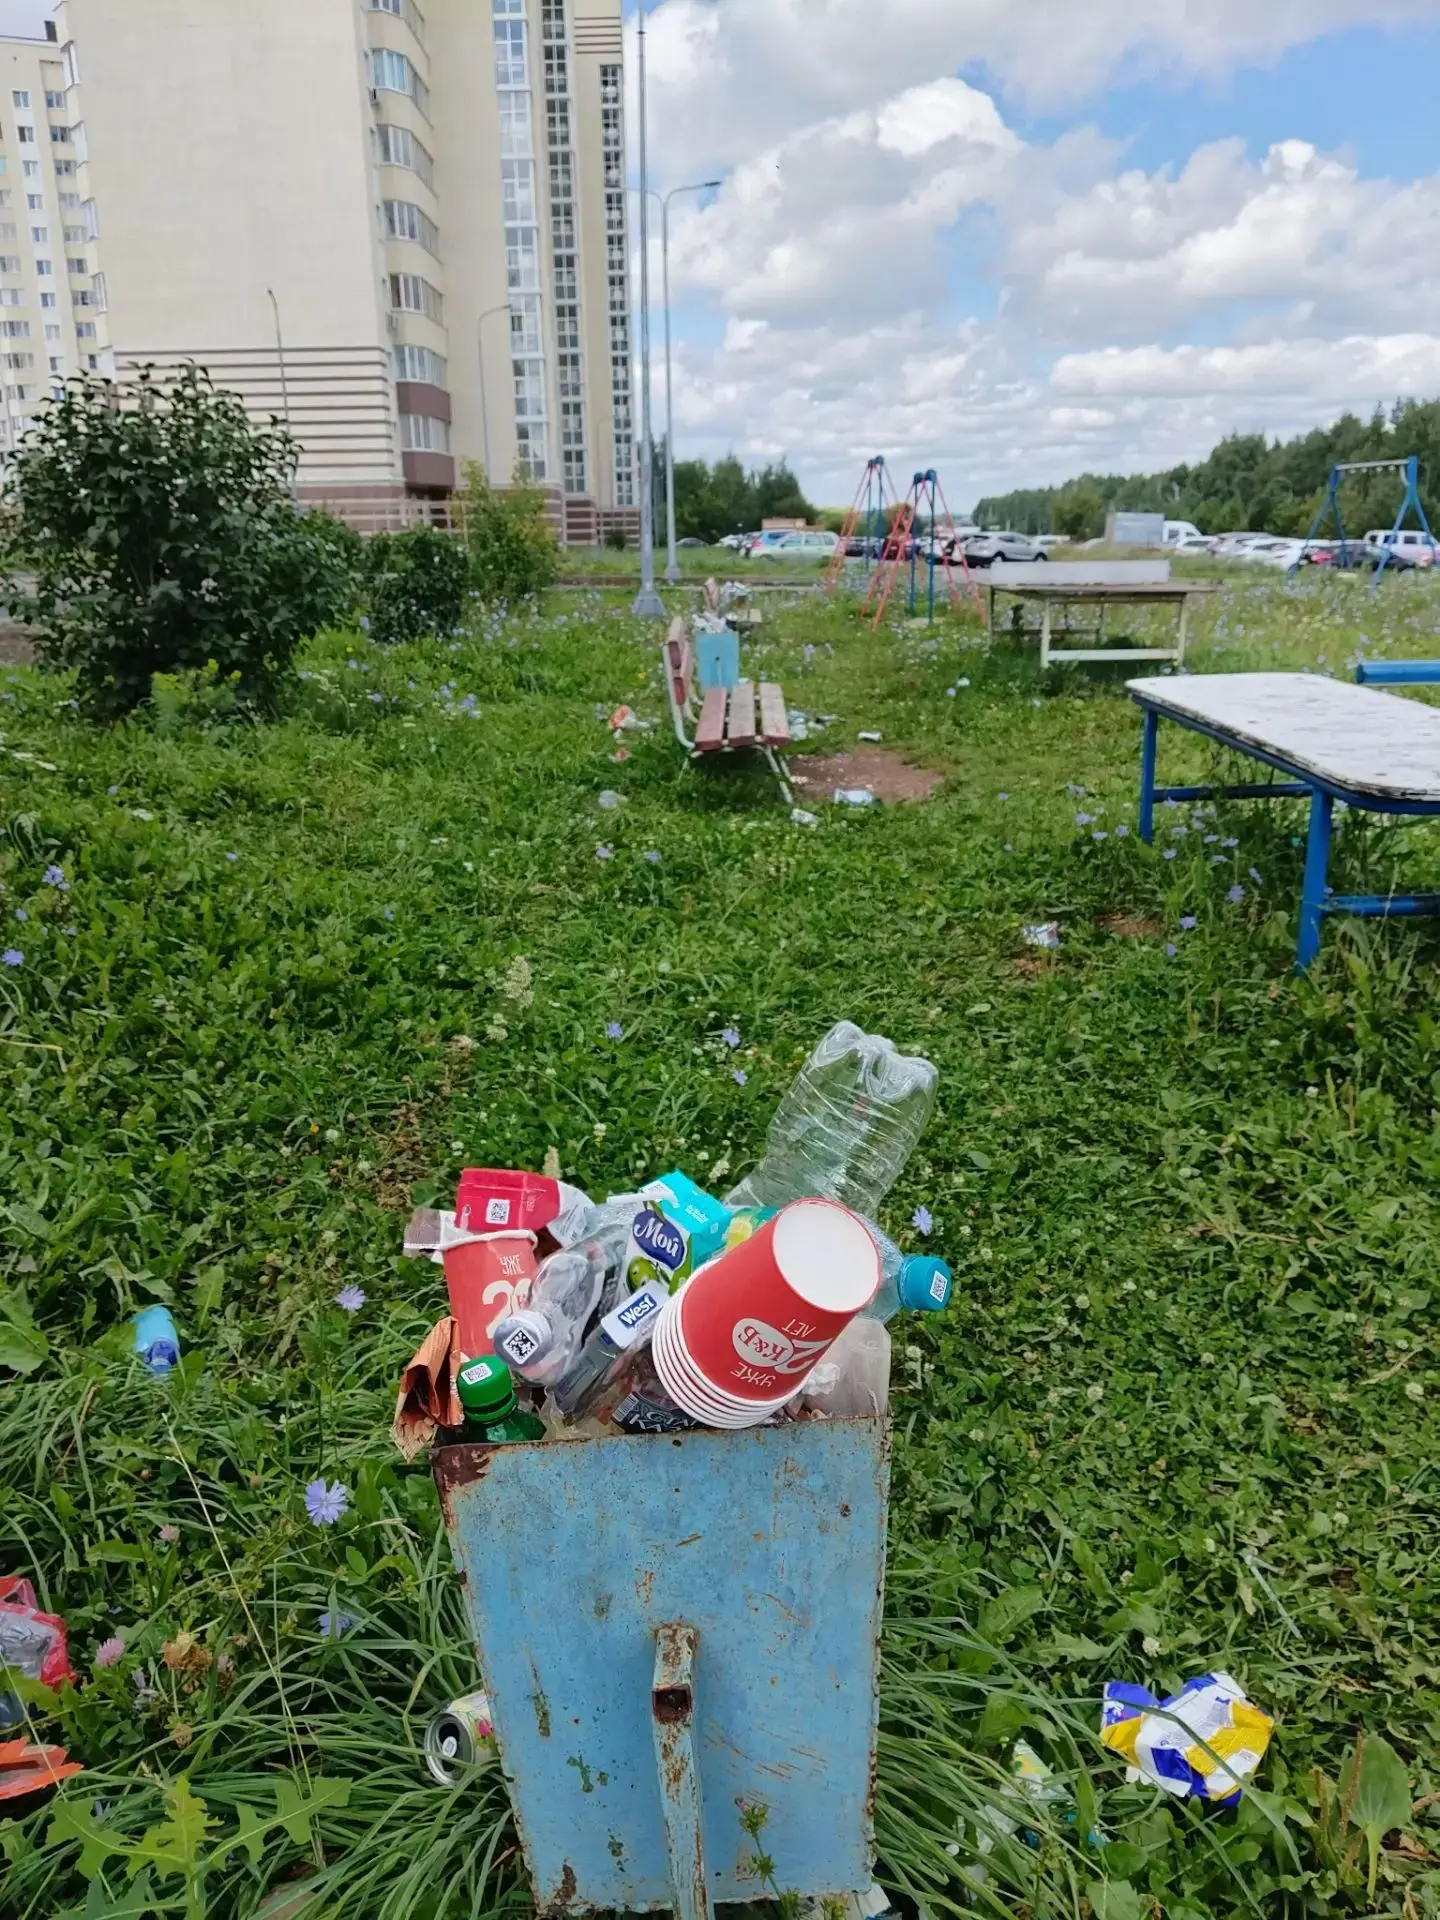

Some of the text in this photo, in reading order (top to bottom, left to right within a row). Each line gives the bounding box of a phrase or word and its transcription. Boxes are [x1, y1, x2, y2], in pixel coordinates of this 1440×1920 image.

[633, 1218, 680, 1258] Мой
[500, 1254, 525, 1276] УЖЕ
[620, 1294, 655, 1325] West
[781, 1318, 817, 1338] ЛЕТ
[730, 1361, 777, 1388] УЖЕ
